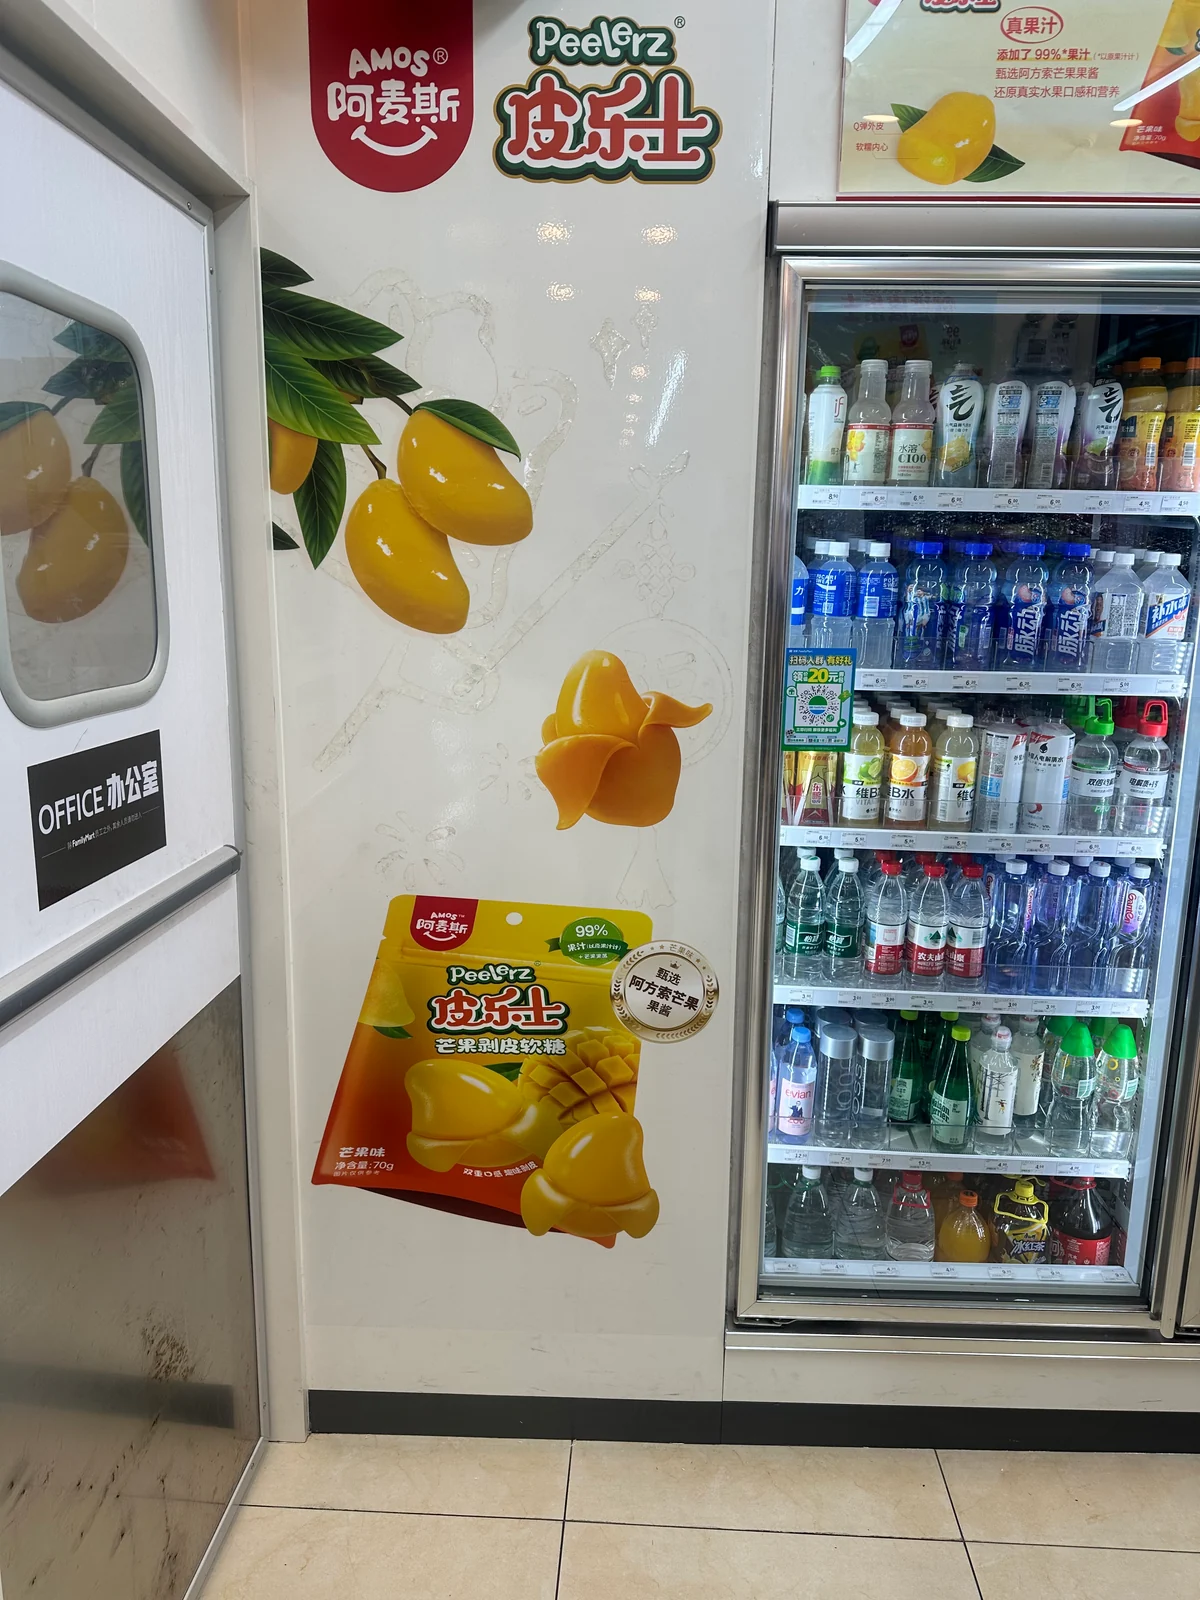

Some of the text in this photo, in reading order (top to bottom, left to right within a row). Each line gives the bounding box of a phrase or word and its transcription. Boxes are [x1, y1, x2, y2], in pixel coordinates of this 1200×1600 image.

[1005, 16, 1058, 35] 真果汁
[996, 48, 1031, 61] 添加了
[995, 67, 1100, 80] 甄选阿方索芒果果酱
[993, 86, 1121, 99] 还原真实水果口感和营养
[327, 79, 460, 126] 阿麦斯
[503, 72, 712, 169] 皮乐士
[898, 443, 919, 454] 水溶
[898, 453, 927, 464] C100
[826, 655, 852, 665] 有好礼
[38, 760, 160, 835] OFFICE 办公室
[416, 919, 469, 935] 阿麦斯
[575, 924, 609, 938] 99%
[669, 943, 695, 959] 芒果味
[655, 967, 682, 987] 甄选
[628, 975, 701, 1012] 阿方索芒果
[431, 985, 566, 1030] 皮乐士
[646, 999, 673, 1018] 果酱
[435, 1037, 567, 1055] 芒果剥皮软糖
[338, 1146, 386, 1158] 芒果味
[335, 1160, 395, 1172] 净含量:70g
[462, 1160, 539, 1178] 双重口感 趣味剥皮
